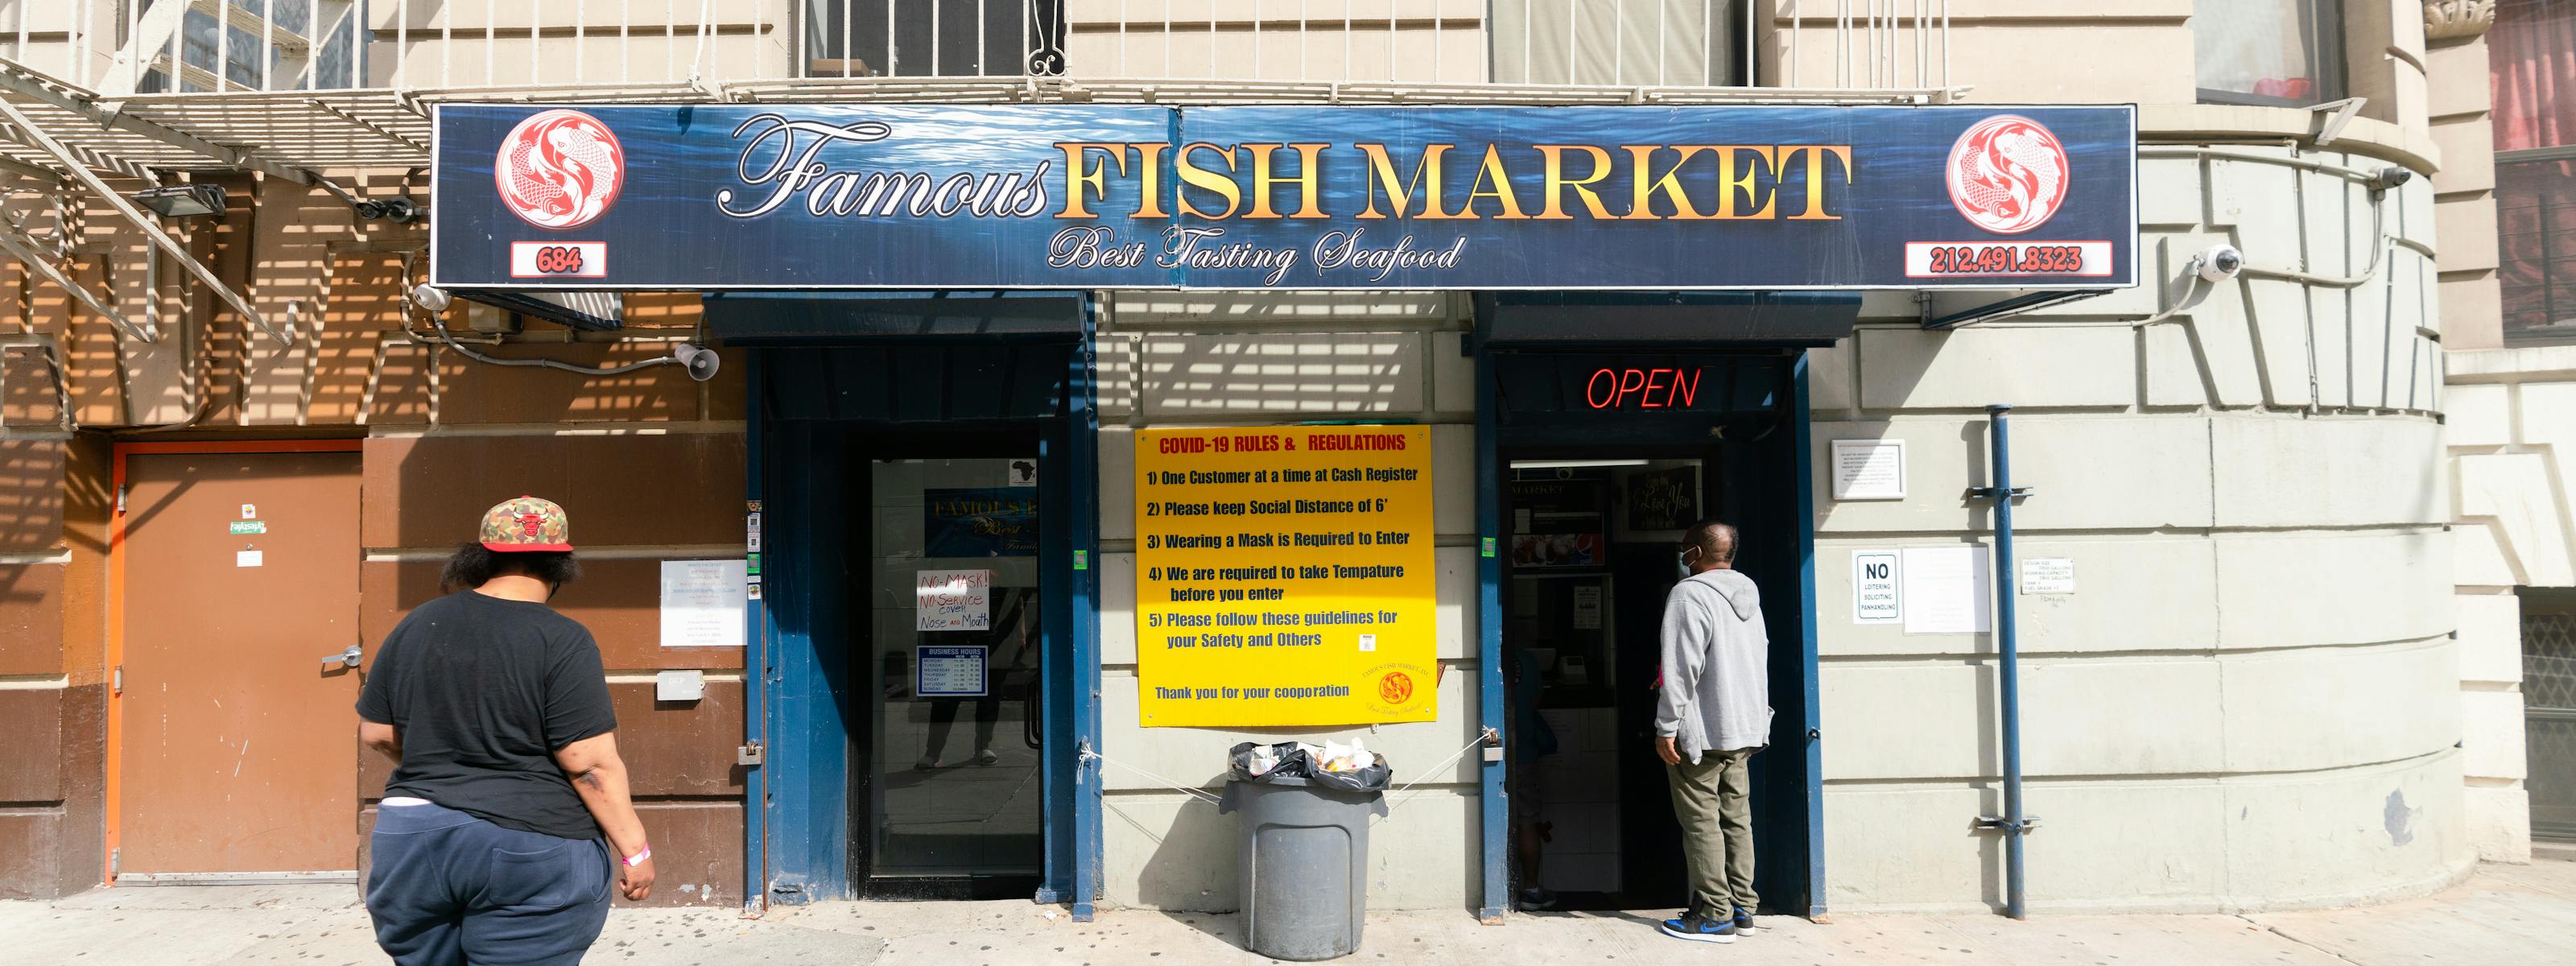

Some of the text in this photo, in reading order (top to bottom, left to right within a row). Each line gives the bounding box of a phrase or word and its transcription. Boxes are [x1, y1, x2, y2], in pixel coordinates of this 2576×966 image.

[718, 113, 1852, 220] Famous FISH MARKET
[536, 246, 582, 273] 684
[1048, 225, 1467, 285] Best Tasting Seafood
[1930, 246, 2083, 273] 212.491.8323
[1587, 369, 1701, 408] OPEN
[1159, 434, 1406, 454] COVID-19 RULES & REGULATIONS
[1146, 467, 1418, 485] 1) One Customer at a time at Cash Register
[934, 501, 1019, 516] FAMOUS
[1147, 502, 1160, 516] 2)
[1165, 502, 1209, 516] Please
[1213, 501, 1245, 515] keep
[1249, 500, 1291, 514] Social
[1295, 499, 1354, 514] Distance
[1358, 498, 1372, 512] of
[1147, 531, 1410, 549] 3) Wearing a Mask is Required to Enter
[1149, 564, 1405, 581] 4) We are required to take Tempature
[1866, 563, 1889, 580] NO
[1170, 587, 1284, 602] before you enter
[920, 615, 947, 630] Nose
[961, 613, 989, 628] Mouth
[1149, 609, 1397, 627] 5) Please follow these guidelines for
[1167, 633, 1322, 649] your Safety and Others
[1155, 684, 1349, 700] Thank you for your cooporation
